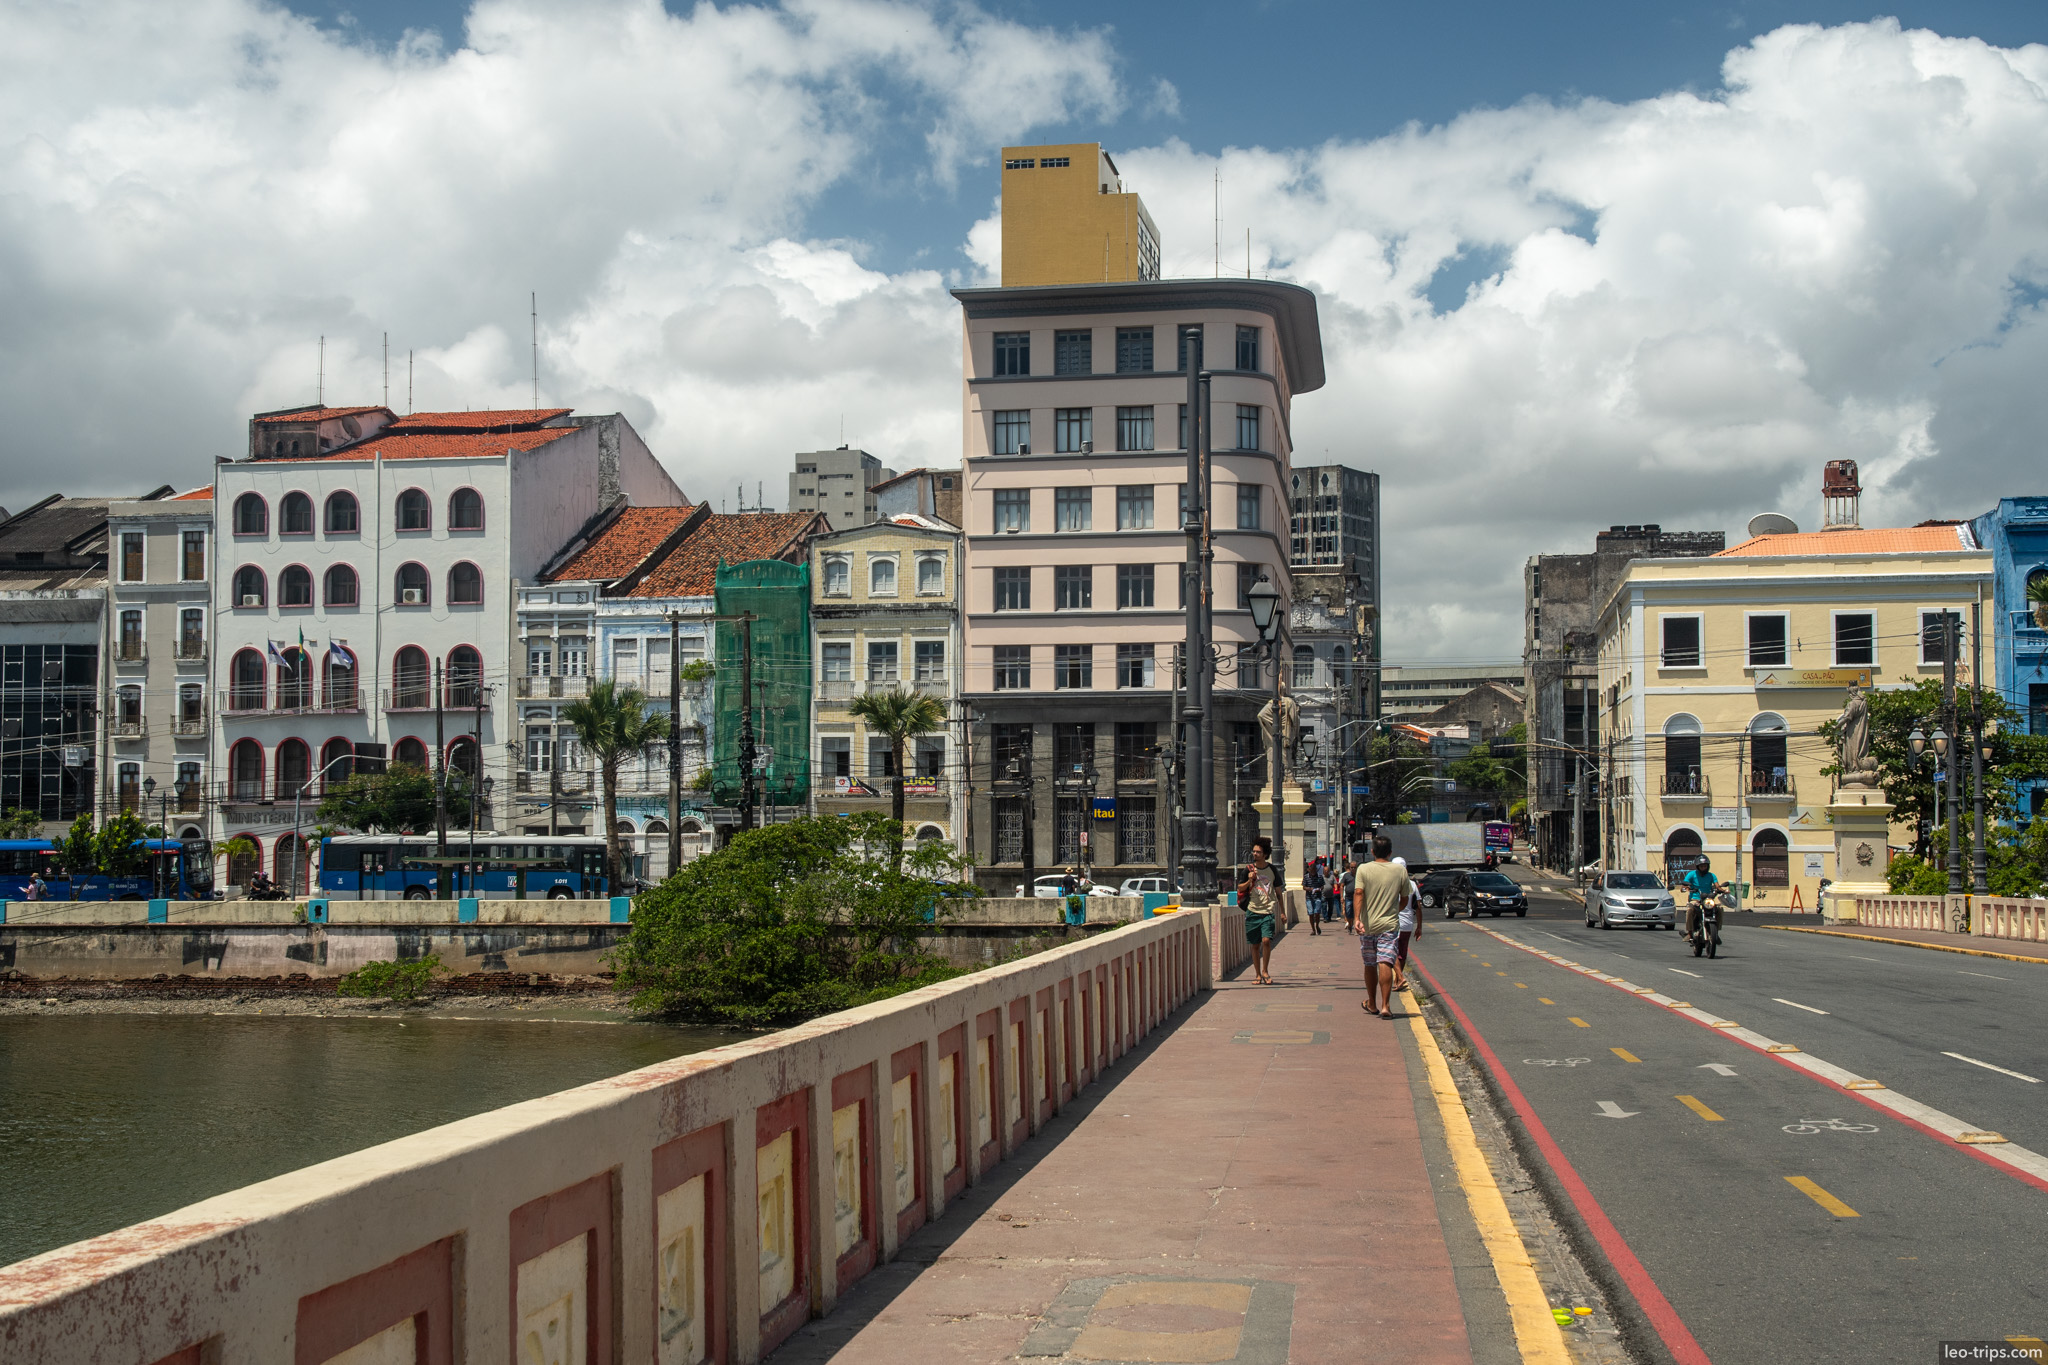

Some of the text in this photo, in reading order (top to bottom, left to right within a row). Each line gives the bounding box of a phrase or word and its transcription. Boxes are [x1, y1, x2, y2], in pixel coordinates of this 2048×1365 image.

[1802, 672, 1818, 680] CASA
[1822, 671, 1835, 680] PÃO
[904, 776, 936, 786] LUGO
[226, 808, 297, 824] MINISTÉRIO
[1093, 808, 1115, 818] Itaú
